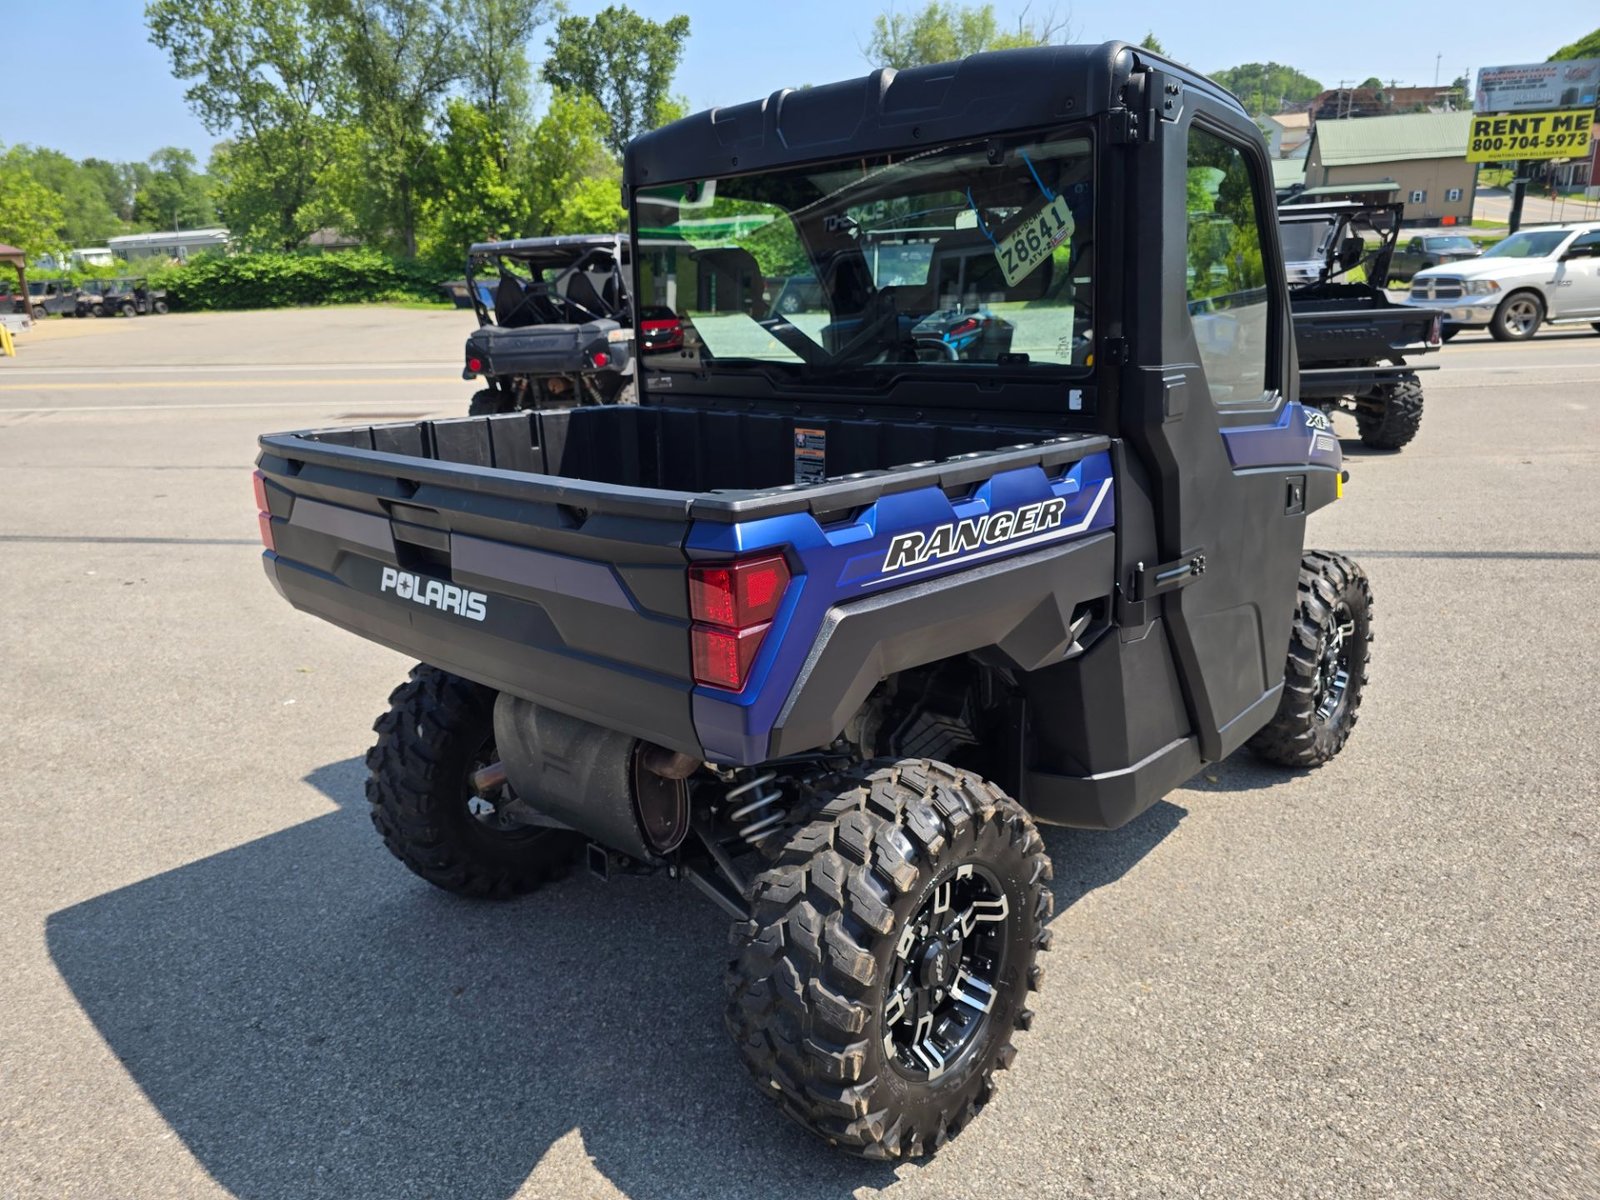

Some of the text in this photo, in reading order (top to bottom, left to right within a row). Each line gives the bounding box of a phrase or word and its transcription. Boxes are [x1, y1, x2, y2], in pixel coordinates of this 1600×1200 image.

[1472, 132, 1588, 152] 800-704-5973
[1474, 113, 1592, 138] RENT ME
[1001, 206, 1067, 275] Z8641
[881, 498, 1067, 573] RANGER
[380, 566, 488, 622] POLARIS
